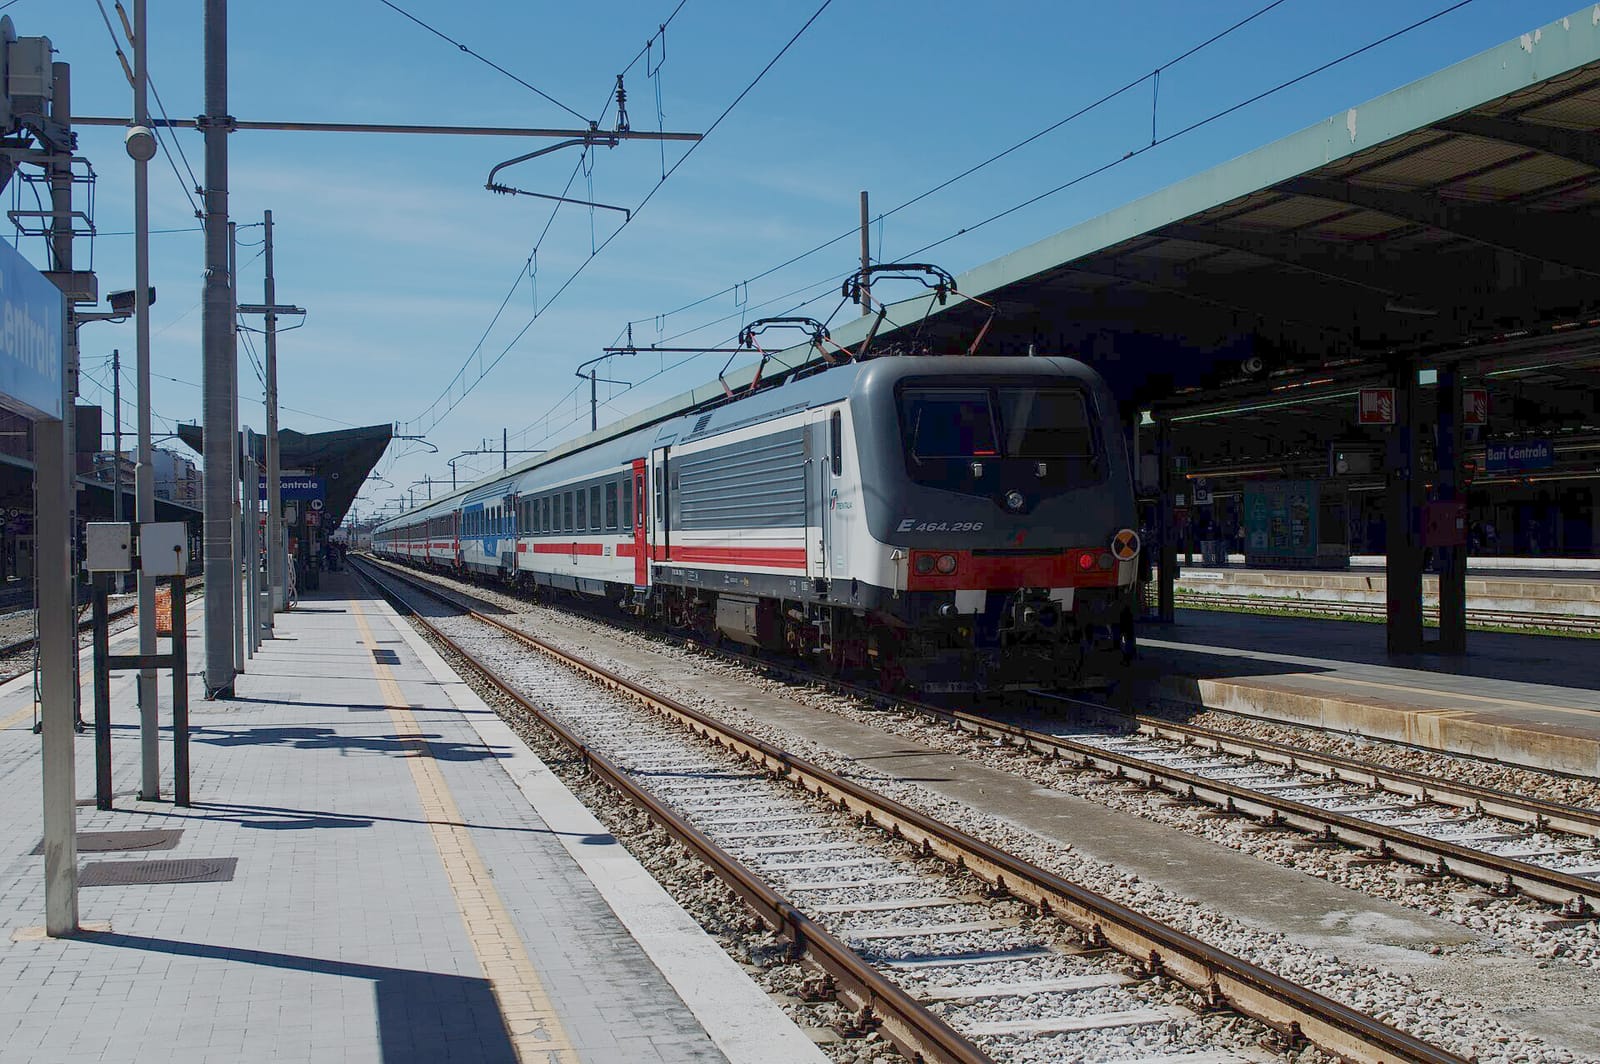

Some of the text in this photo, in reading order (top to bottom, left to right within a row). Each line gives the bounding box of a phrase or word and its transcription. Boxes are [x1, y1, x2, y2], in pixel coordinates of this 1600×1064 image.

[0, 300, 56, 382] entrale
[1487, 443, 1548, 461] Bari Centrale
[279, 480, 318, 489] entrale
[896, 519, 984, 532] E 464.296
